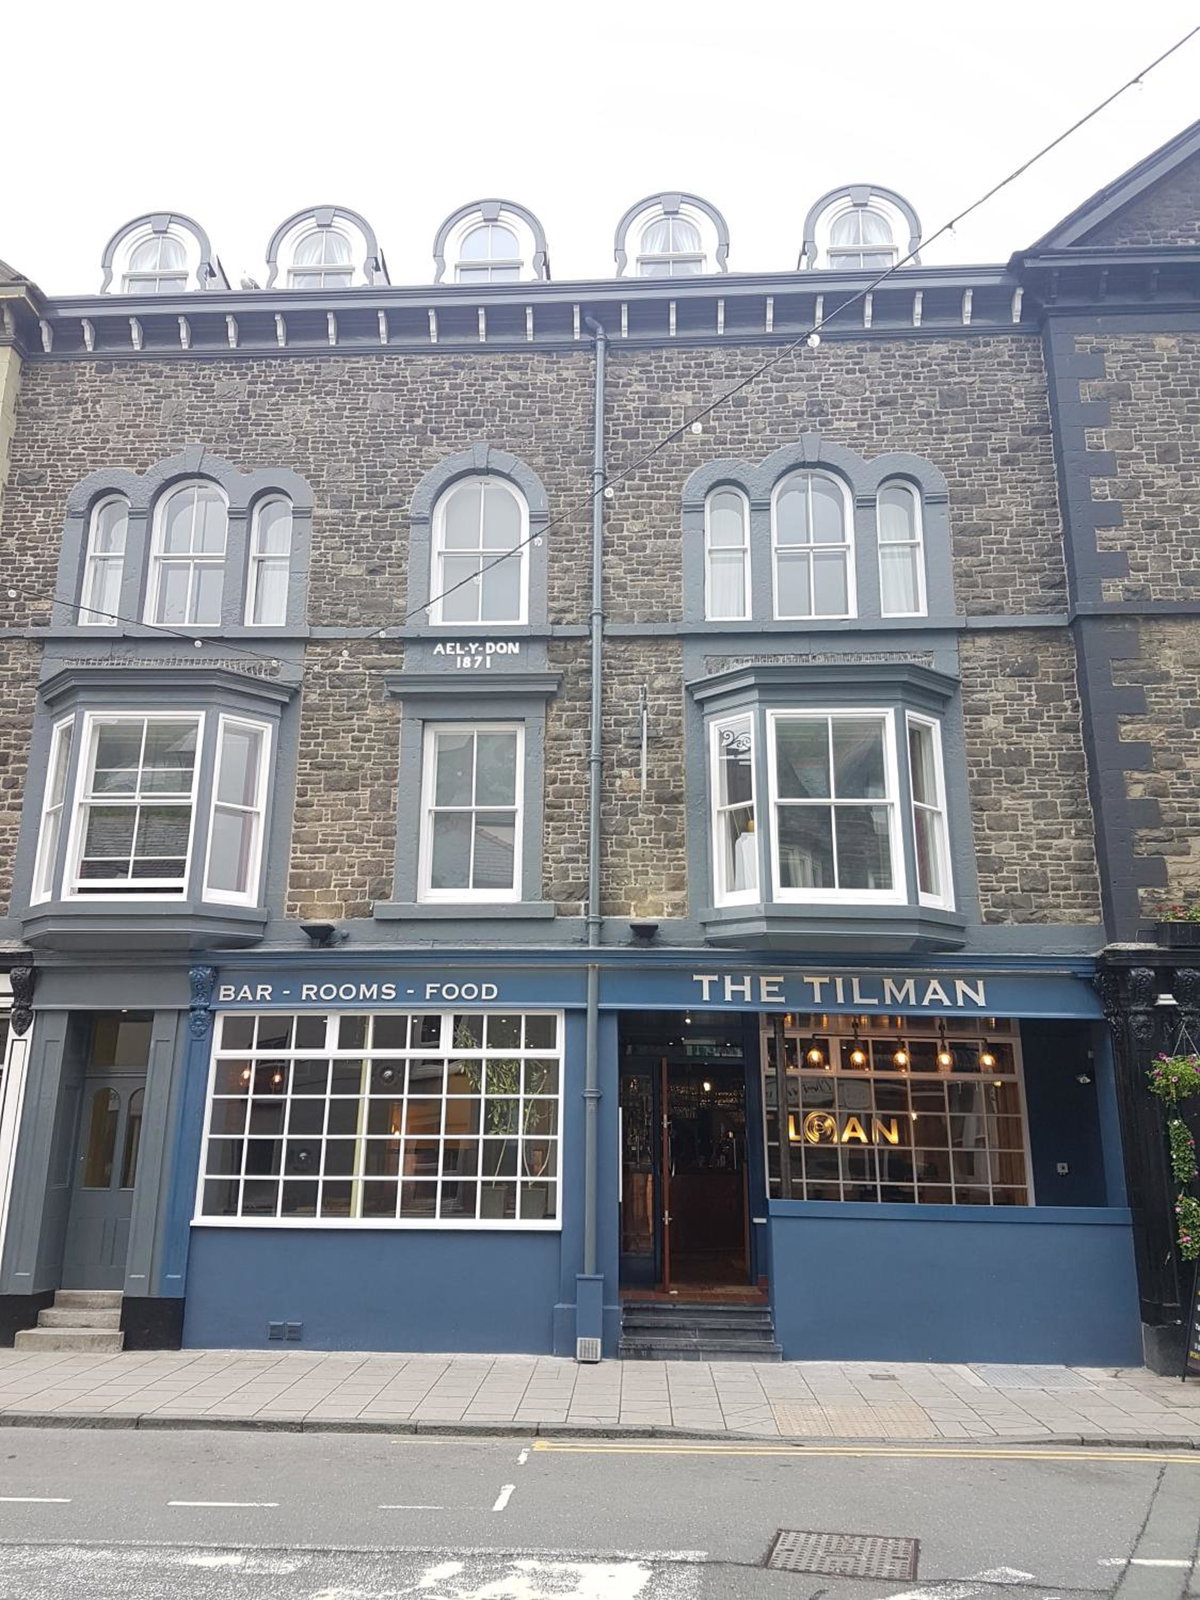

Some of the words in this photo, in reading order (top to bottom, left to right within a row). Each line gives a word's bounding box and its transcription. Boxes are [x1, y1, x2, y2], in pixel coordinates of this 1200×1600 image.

[433, 642, 519, 655] AEL-Y-DON
[456, 656, 491, 668] 1871
[219, 985, 272, 1001] BAR
[301, 984, 397, 1000] ROOMS
[425, 983, 498, 1000] FOOD
[693, 974, 785, 1003] THE
[803, 976, 986, 1007] TILMAN
